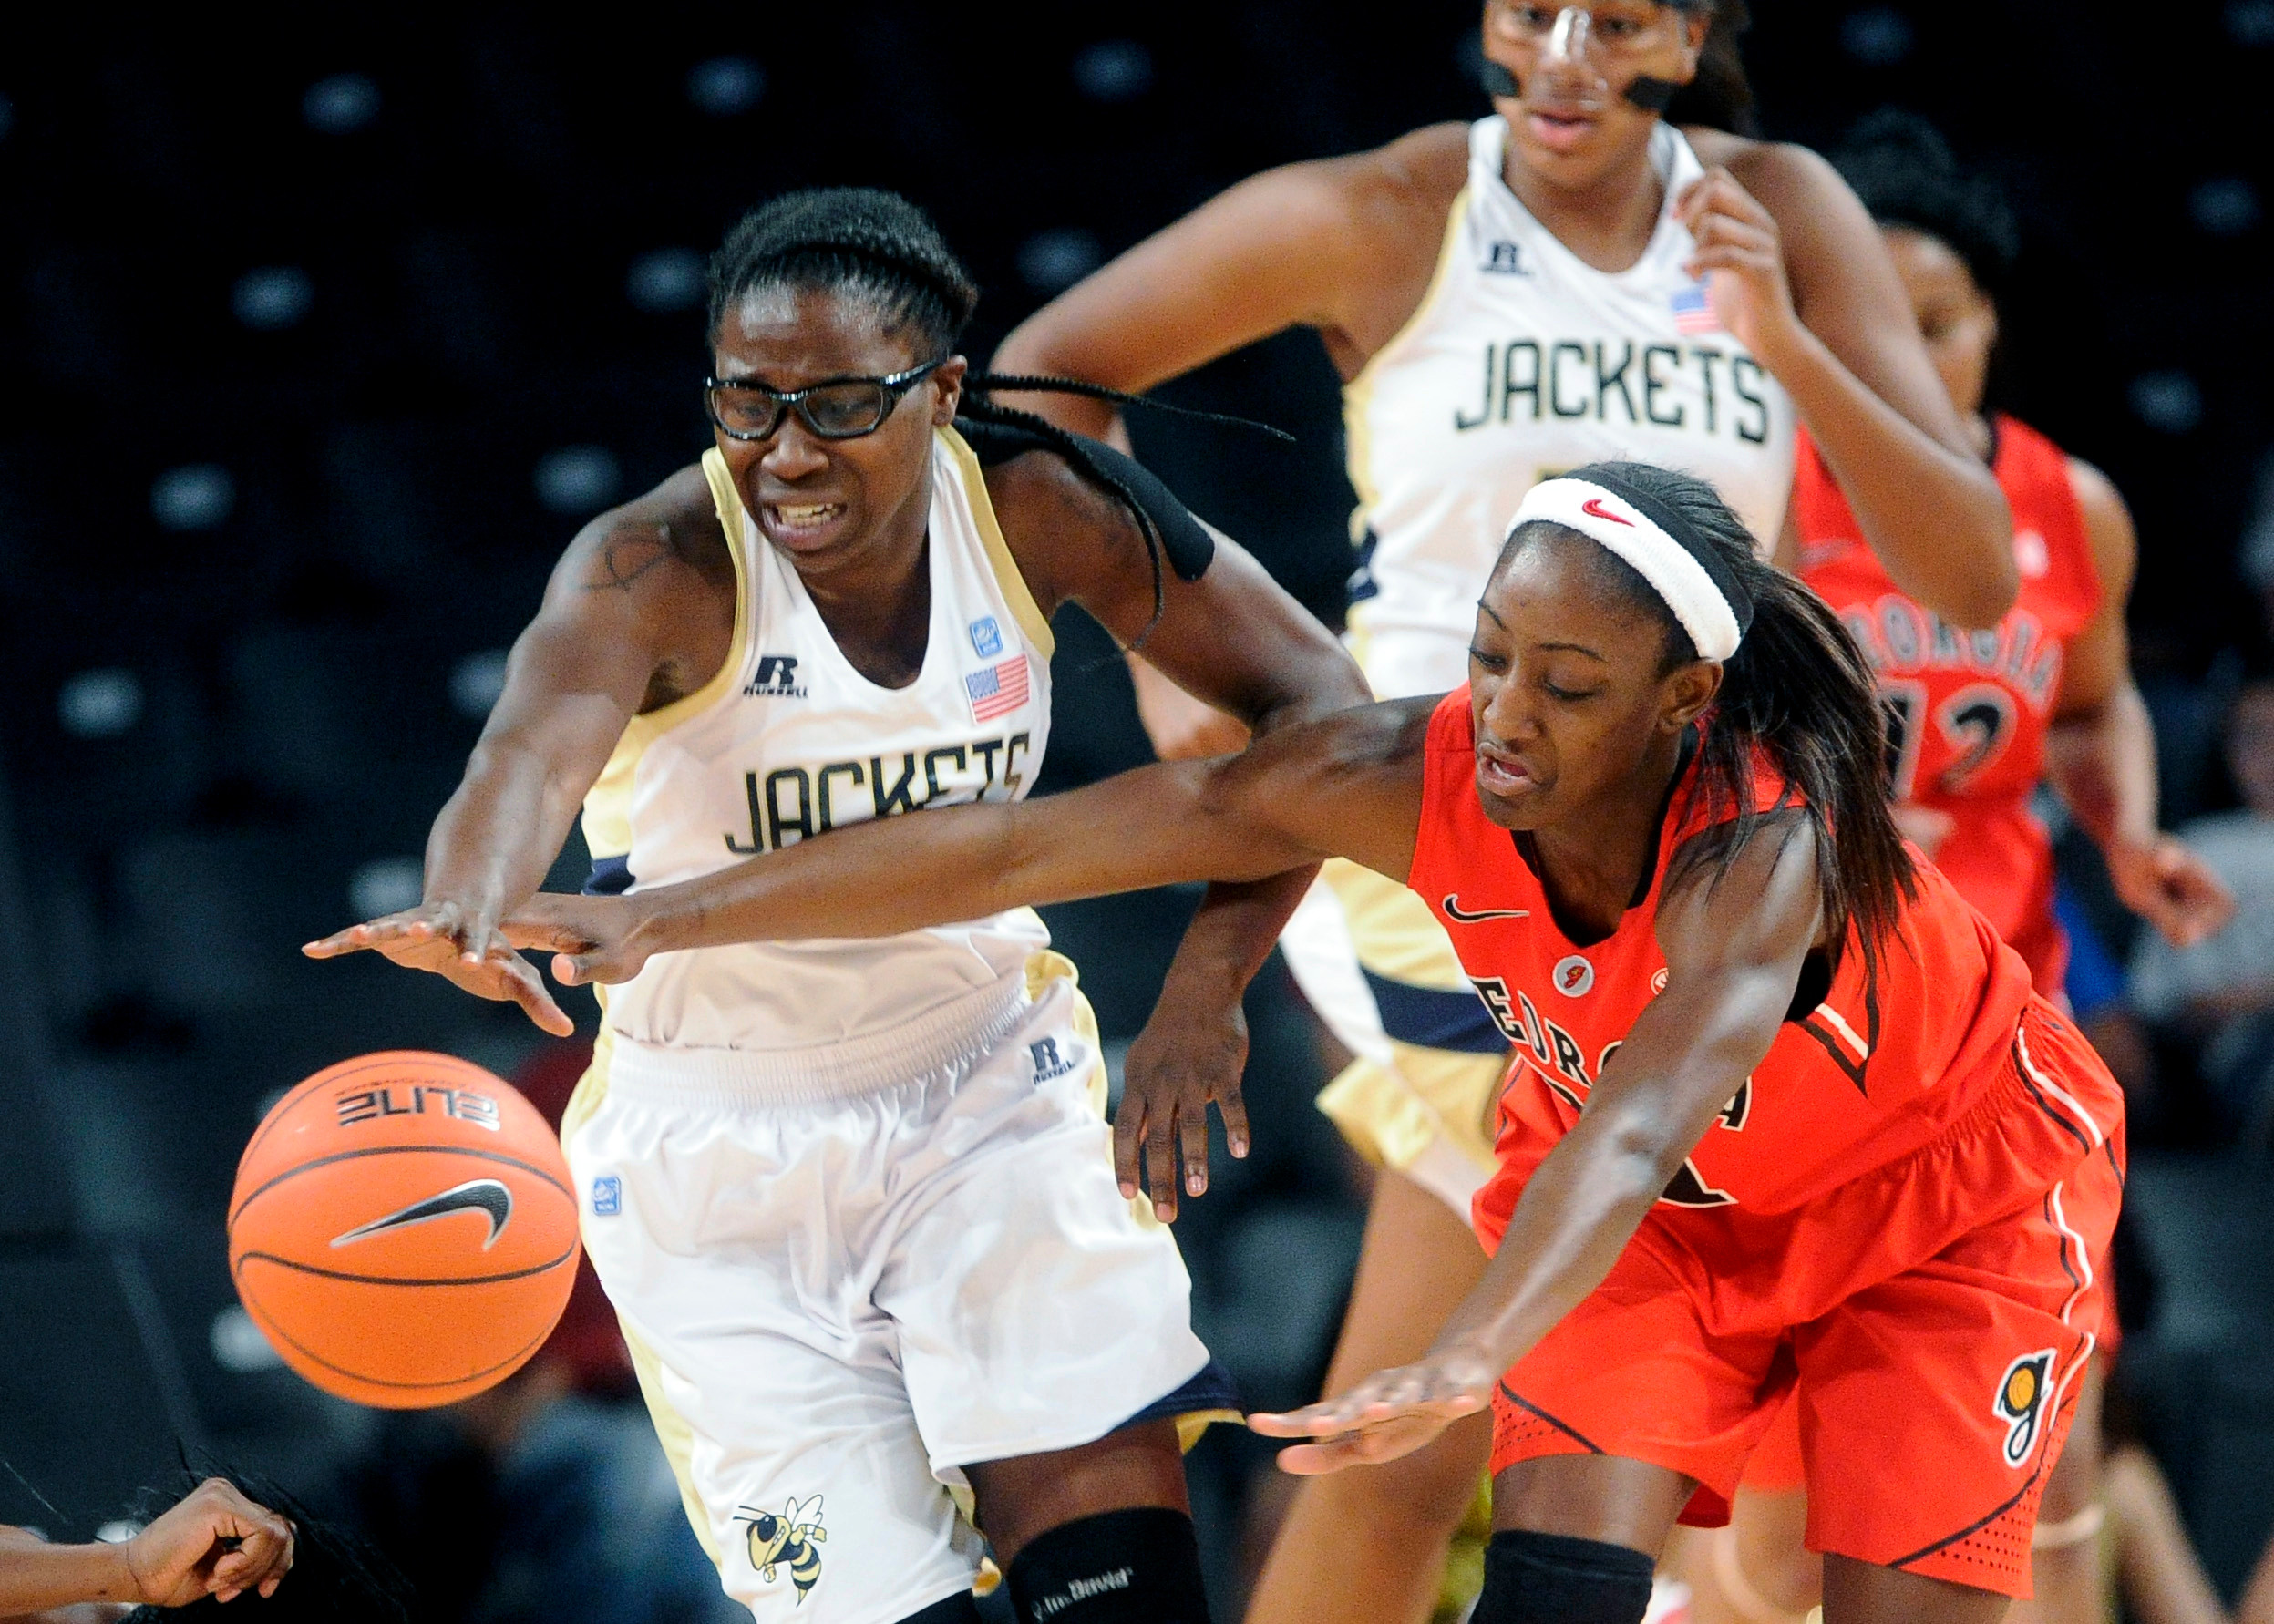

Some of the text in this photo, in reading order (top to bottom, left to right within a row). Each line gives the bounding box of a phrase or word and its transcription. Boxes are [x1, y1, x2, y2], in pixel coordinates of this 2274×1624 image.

[1456, 337, 1771, 444] JACKETS
[754, 656, 798, 685] R
[1029, 1036, 1061, 1073] R
[335, 1084, 501, 1132] ELITE
